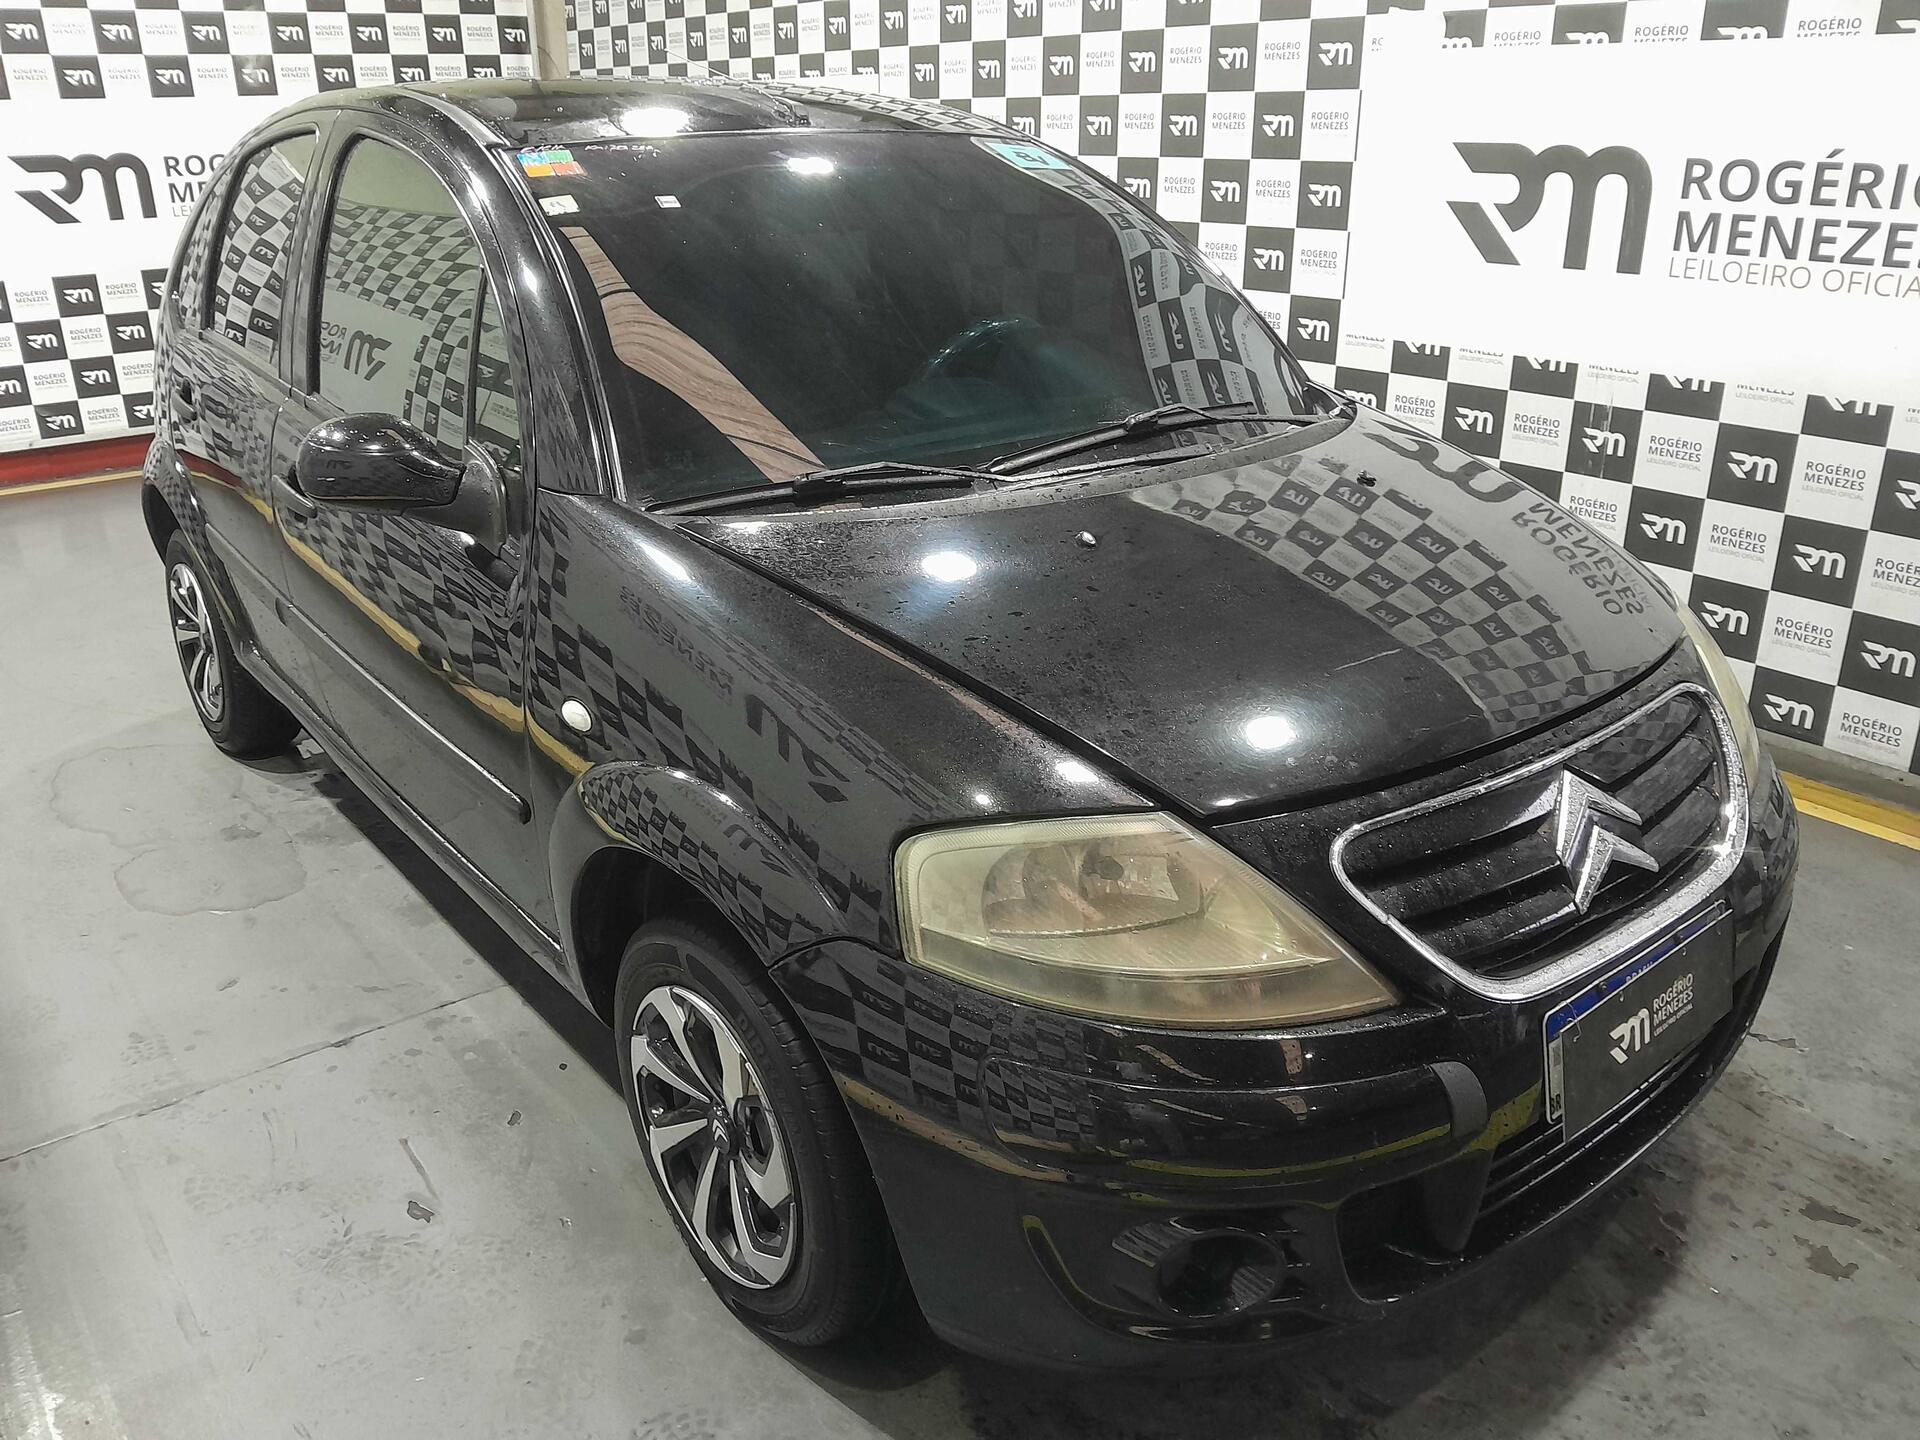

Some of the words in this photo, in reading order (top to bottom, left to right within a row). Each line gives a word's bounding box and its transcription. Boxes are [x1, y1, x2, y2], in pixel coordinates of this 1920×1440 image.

[1013, 0, 1037, 18] RM
[4, 23, 40, 41] RM
[101, 23, 133, 40] RM
[192, 25, 221, 41] RM
[277, 25, 304, 41] RM
[356, 26, 383, 42] RM
[432, 27, 456, 42] RM
[1129, 51, 1156, 72] RM
[1218, 47, 1248, 70] RM
[1318, 41, 1353, 66] RM
[323, 67, 349, 83] RM
[400, 67, 424, 81] RM
[1049, 55, 1074, 76] RM
[62, 69, 96, 86] RM
[155, 68, 186, 85] RM
[1086, 115, 1112, 136] RM
[1168, 115, 1198, 136] RM
[1262, 114, 1294, 137] RM
[7, 152, 157, 224] RM
[1124, 177, 1150, 198] RM
[1680, 148, 1920, 211] ROGÉRI
[1210, 180, 1240, 202] RM
[1256, 189, 1291, 198] MENEZES
[1308, 184, 1342, 207] RM
[1446, 142, 1652, 275] RM
[1672, 210, 1920, 269] MENEZE
[1252, 248, 1284, 271] RM
[1301, 259, 1337, 269] MENEZES
[1669, 256, 1811, 289] LEILOEIRO
[1822, 270, 1920, 299] OFICIA
[63, 288, 94, 303] RM
[116, 325, 146, 340] RM
[1297, 317, 1330, 342] RM
[26, 333, 58, 349] RM
[81, 369, 112, 385] RM
[1394, 404, 1435, 418] MENEZES
[1395, 394, 1435, 409] ROGÉRIO
[46, 414, 76, 430] RM
[1454, 406, 1493, 435] RM
[1514, 412, 1560, 428] ROGÉRIO
[1513, 423, 1559, 439] MENEZES
[1582, 427, 1626, 457] RM
[1649, 435, 1702, 452] ROGÉRIO
[1648, 446, 1701, 463] MENEZES
[1727, 451, 1779, 484] RM
[1806, 460, 1866, 480] ROGÉRIO
[1804, 472, 1865, 492] MENEZES
[1570, 495, 1617, 512] ROGÉRIO
[1569, 505, 1616, 523] MENEZES
[1640, 512, 1686, 545] RM
[1712, 523, 1767, 543] ROGÉRIO
[1710, 535, 1765, 554] MENEZES
[1793, 543, 1846, 579] RM
[1875, 557, 1920, 576] ROGÉR
[1873, 568, 1920, 588] MENEZ
[1701, 601, 1749, 636] RM
[1776, 616, 1833, 638] ROGÉRIO
[1774, 627, 1832, 649] MENEZES
[1860, 640, 1916, 678] RM
[1763, 693, 1815, 730] RM
[1842, 712, 1902, 736] ROGÉRIO
[1840, 723, 1900, 747] MENEZES
[1653, 973, 1694, 1012] ROGÉRIO
[1653, 987, 1694, 1028] MENEZES
[1609, 1008, 1650, 1064] RM
